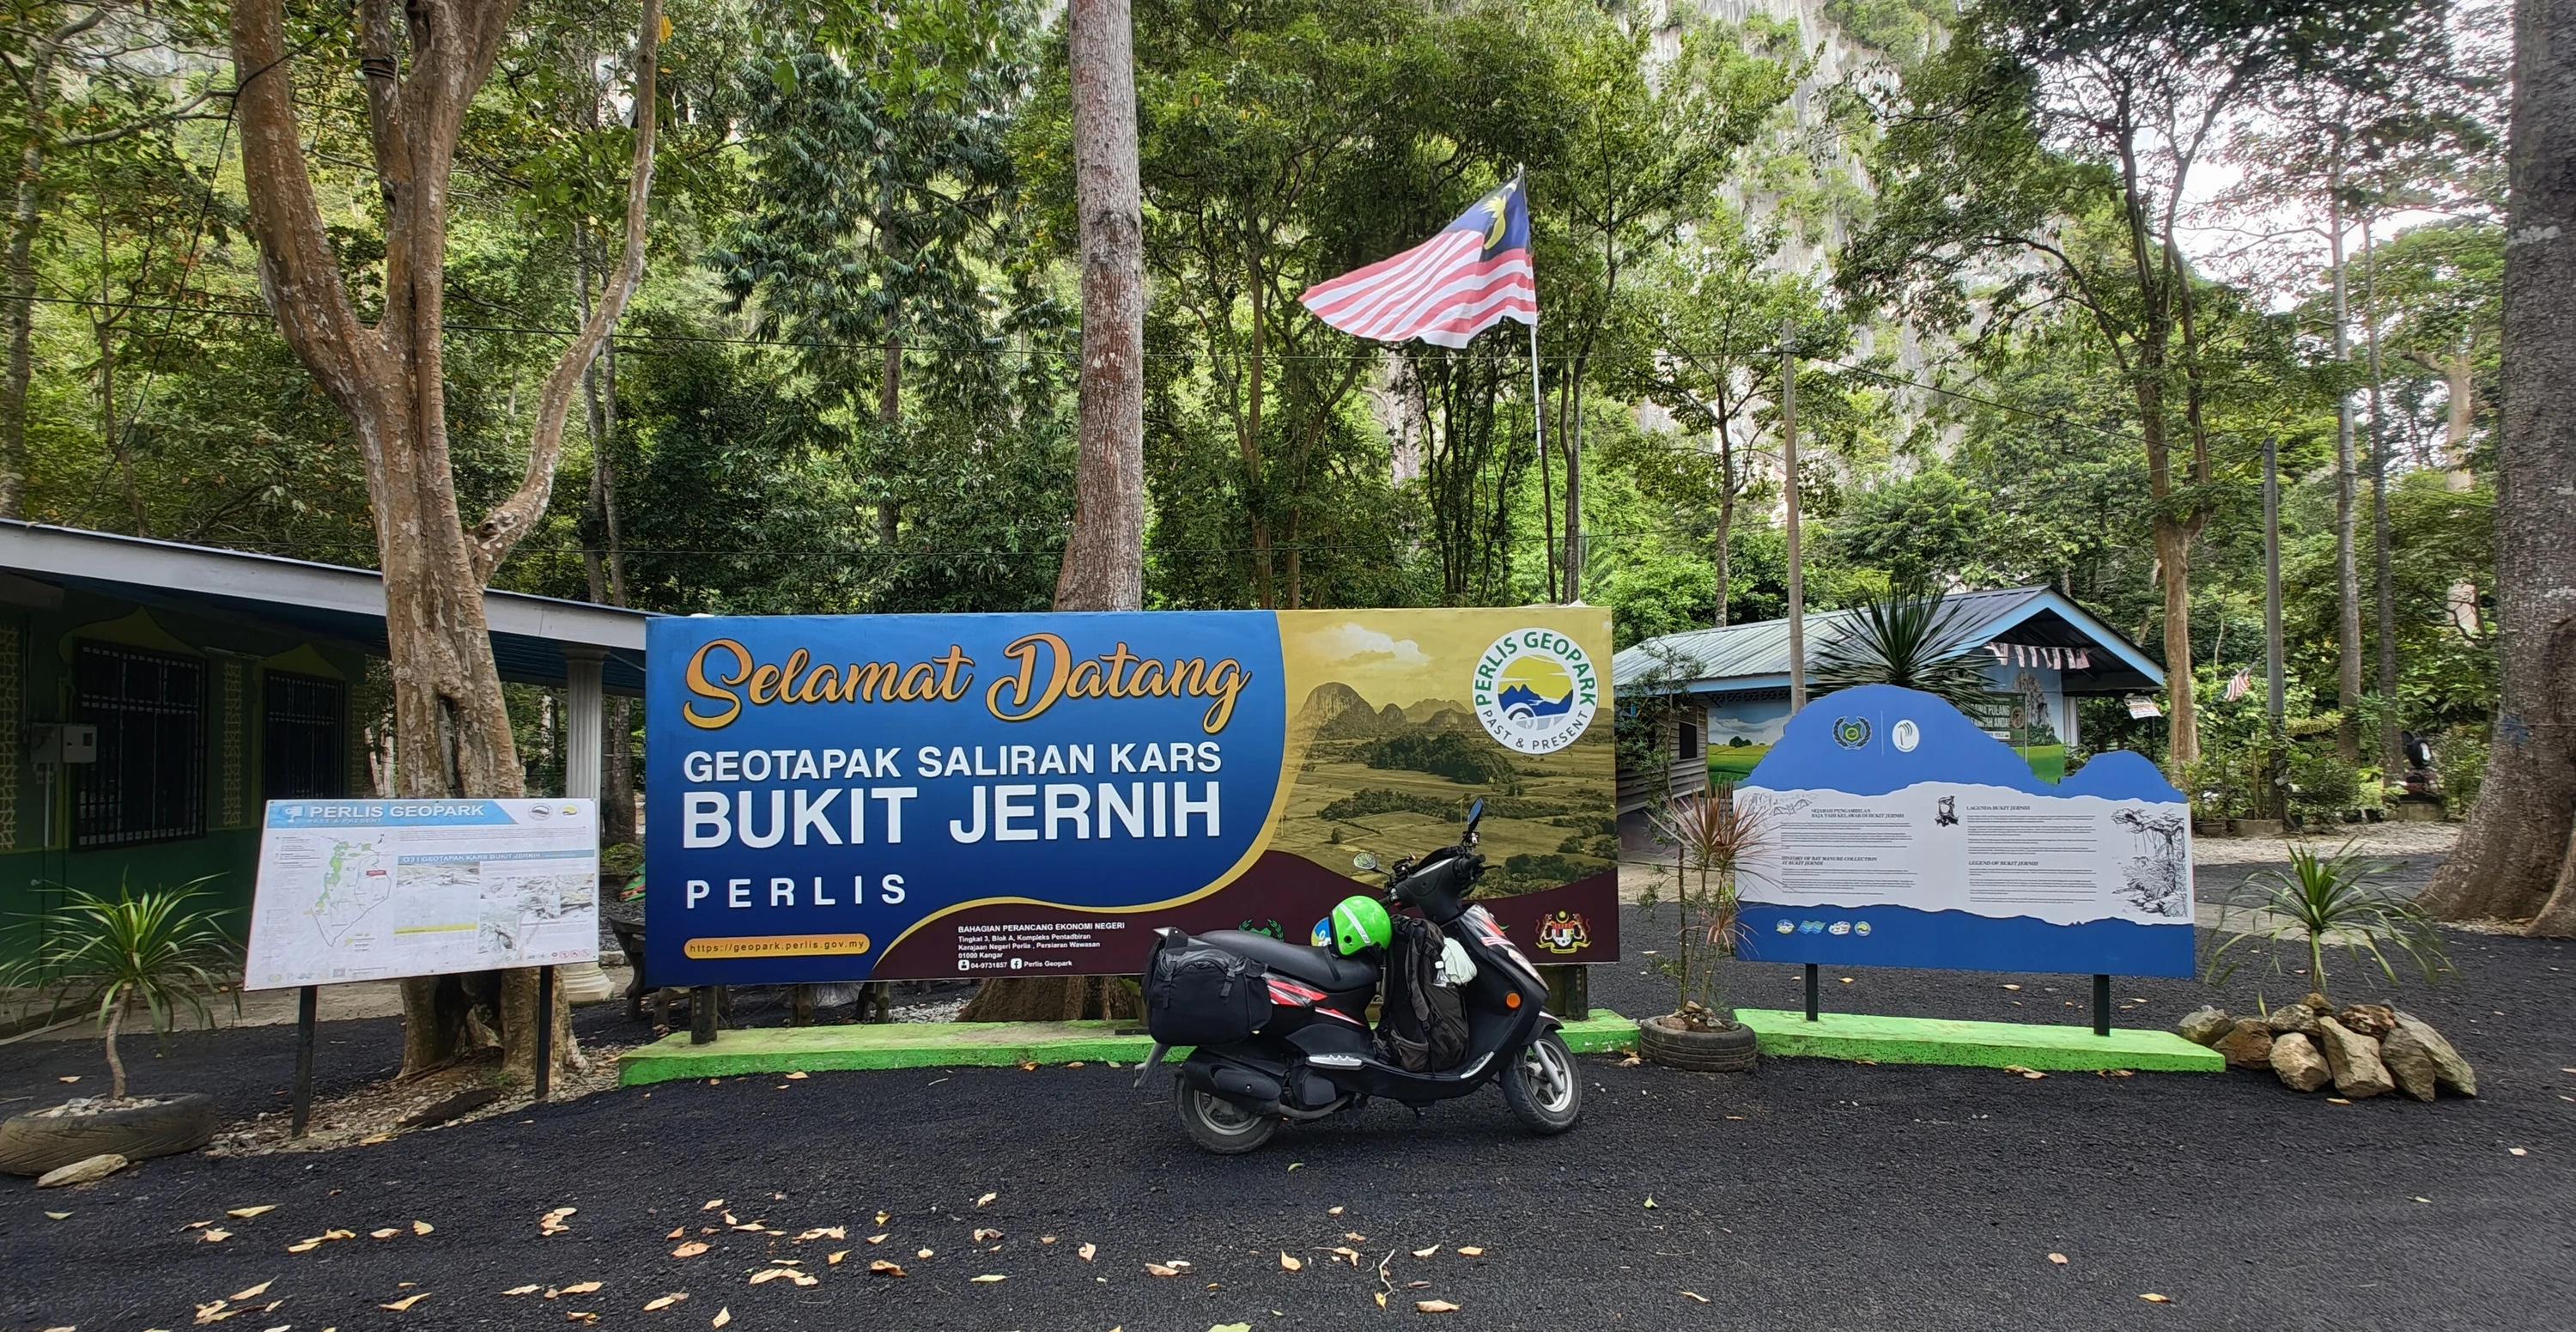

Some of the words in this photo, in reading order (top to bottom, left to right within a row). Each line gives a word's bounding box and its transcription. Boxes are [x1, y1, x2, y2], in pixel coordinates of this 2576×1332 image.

[683, 637, 975, 729] Selamat
[986, 632, 1252, 733] Datang
[1475, 637, 1517, 706] PERLIS
[1523, 631, 1596, 707] GEOPARK
[1483, 709, 1512, 741] PAST
[1516, 738, 1524, 749] &
[1532, 710, 1589, 750] PRESENT
[684, 748, 902, 782] GEOTAPAK
[918, 744, 1095, 777] SALIRAN
[1111, 742, 1222, 774] KARS
[310, 806, 383, 818] PERLIS
[390, 805, 485, 818] GEOPARK
[683, 787, 918, 848] BUKIT
[950, 782, 1220, 843] JERNIH
[687, 874, 906, 909] PERLIS
[690, 940, 865, 953] https://geopark.perlis.gov.my
[1002, 923, 1054, 932] PERANCANG
